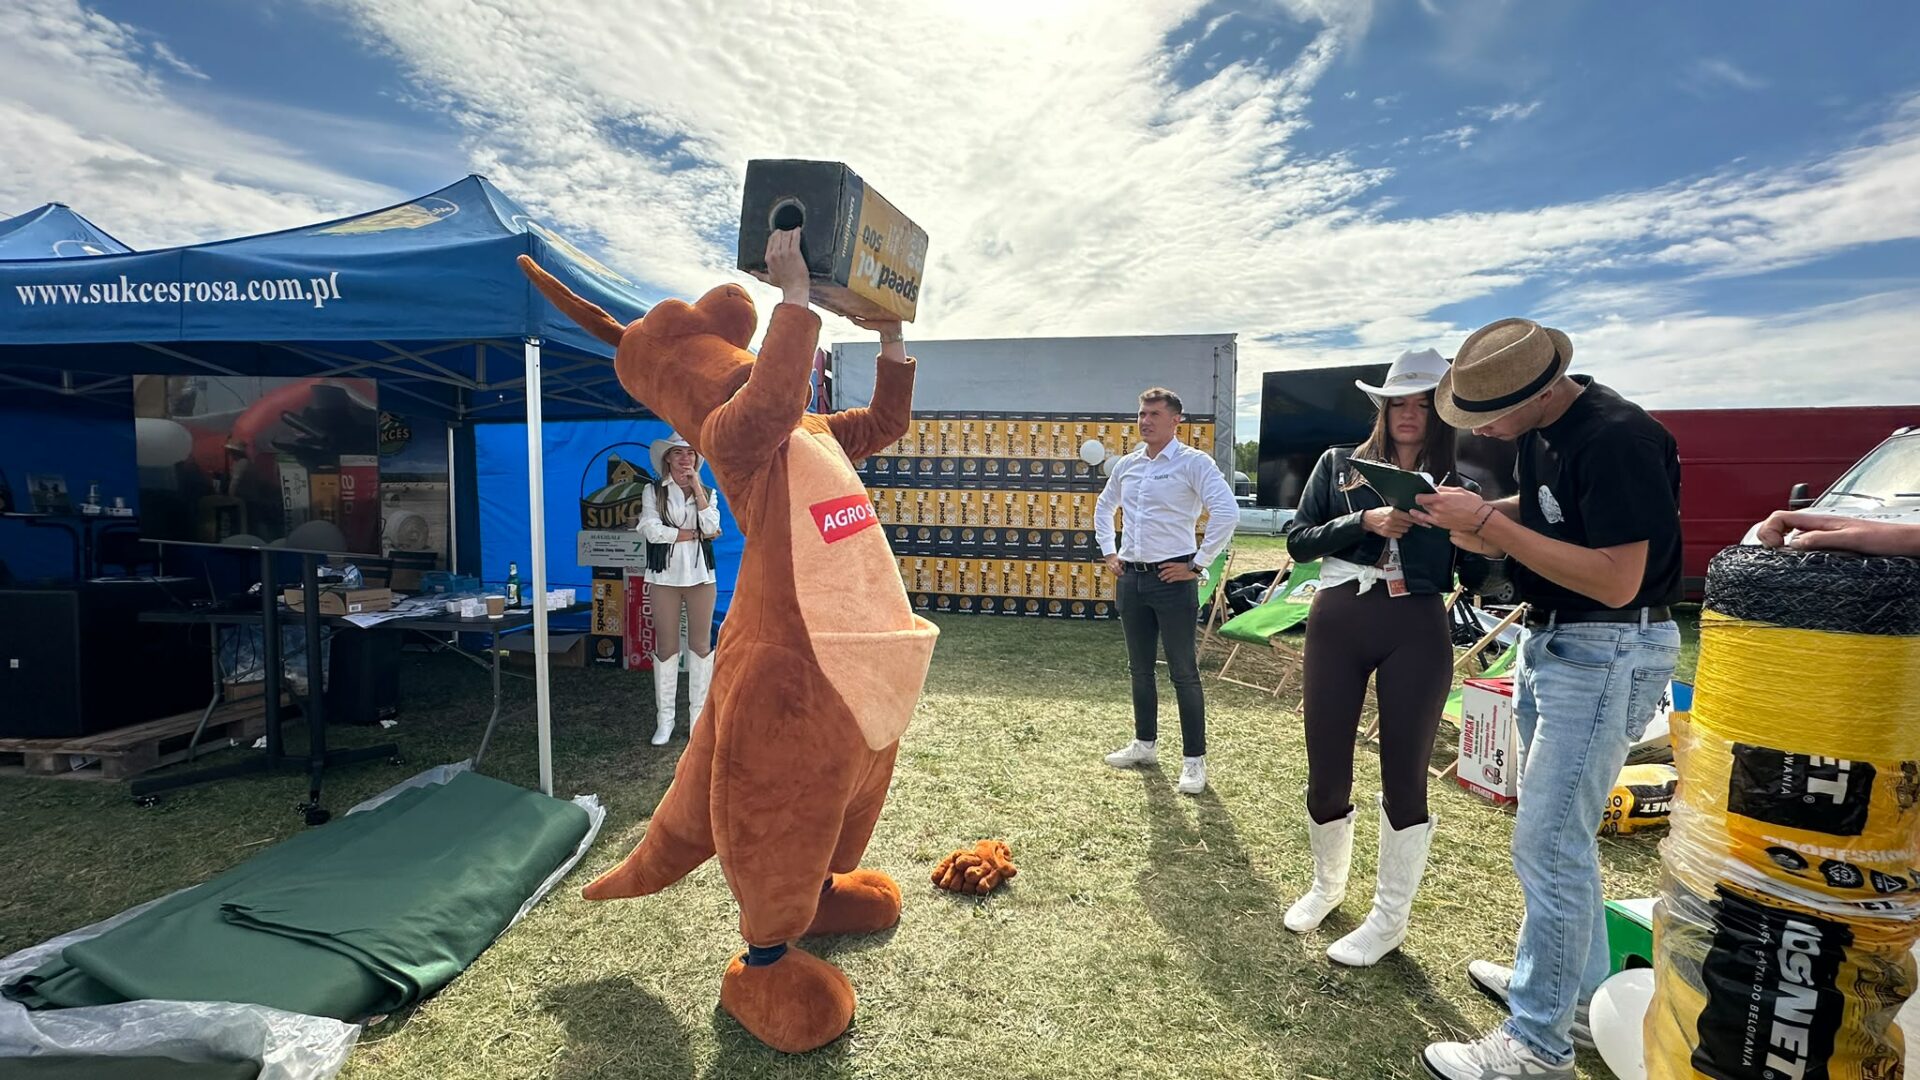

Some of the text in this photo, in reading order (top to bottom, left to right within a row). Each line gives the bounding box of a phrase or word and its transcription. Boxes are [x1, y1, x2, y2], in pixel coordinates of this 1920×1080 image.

[864, 224, 883, 252] 500
[16, 271, 341, 309] www.sukcesrosa.com.pl
[856, 251, 918, 302] speedfol
[823, 503, 875, 533] AGRO S
[596, 583, 605, 631] speedfol
[1463, 719, 1474, 753] SILOPACK
[1751, 984, 1763, 1001] DO
